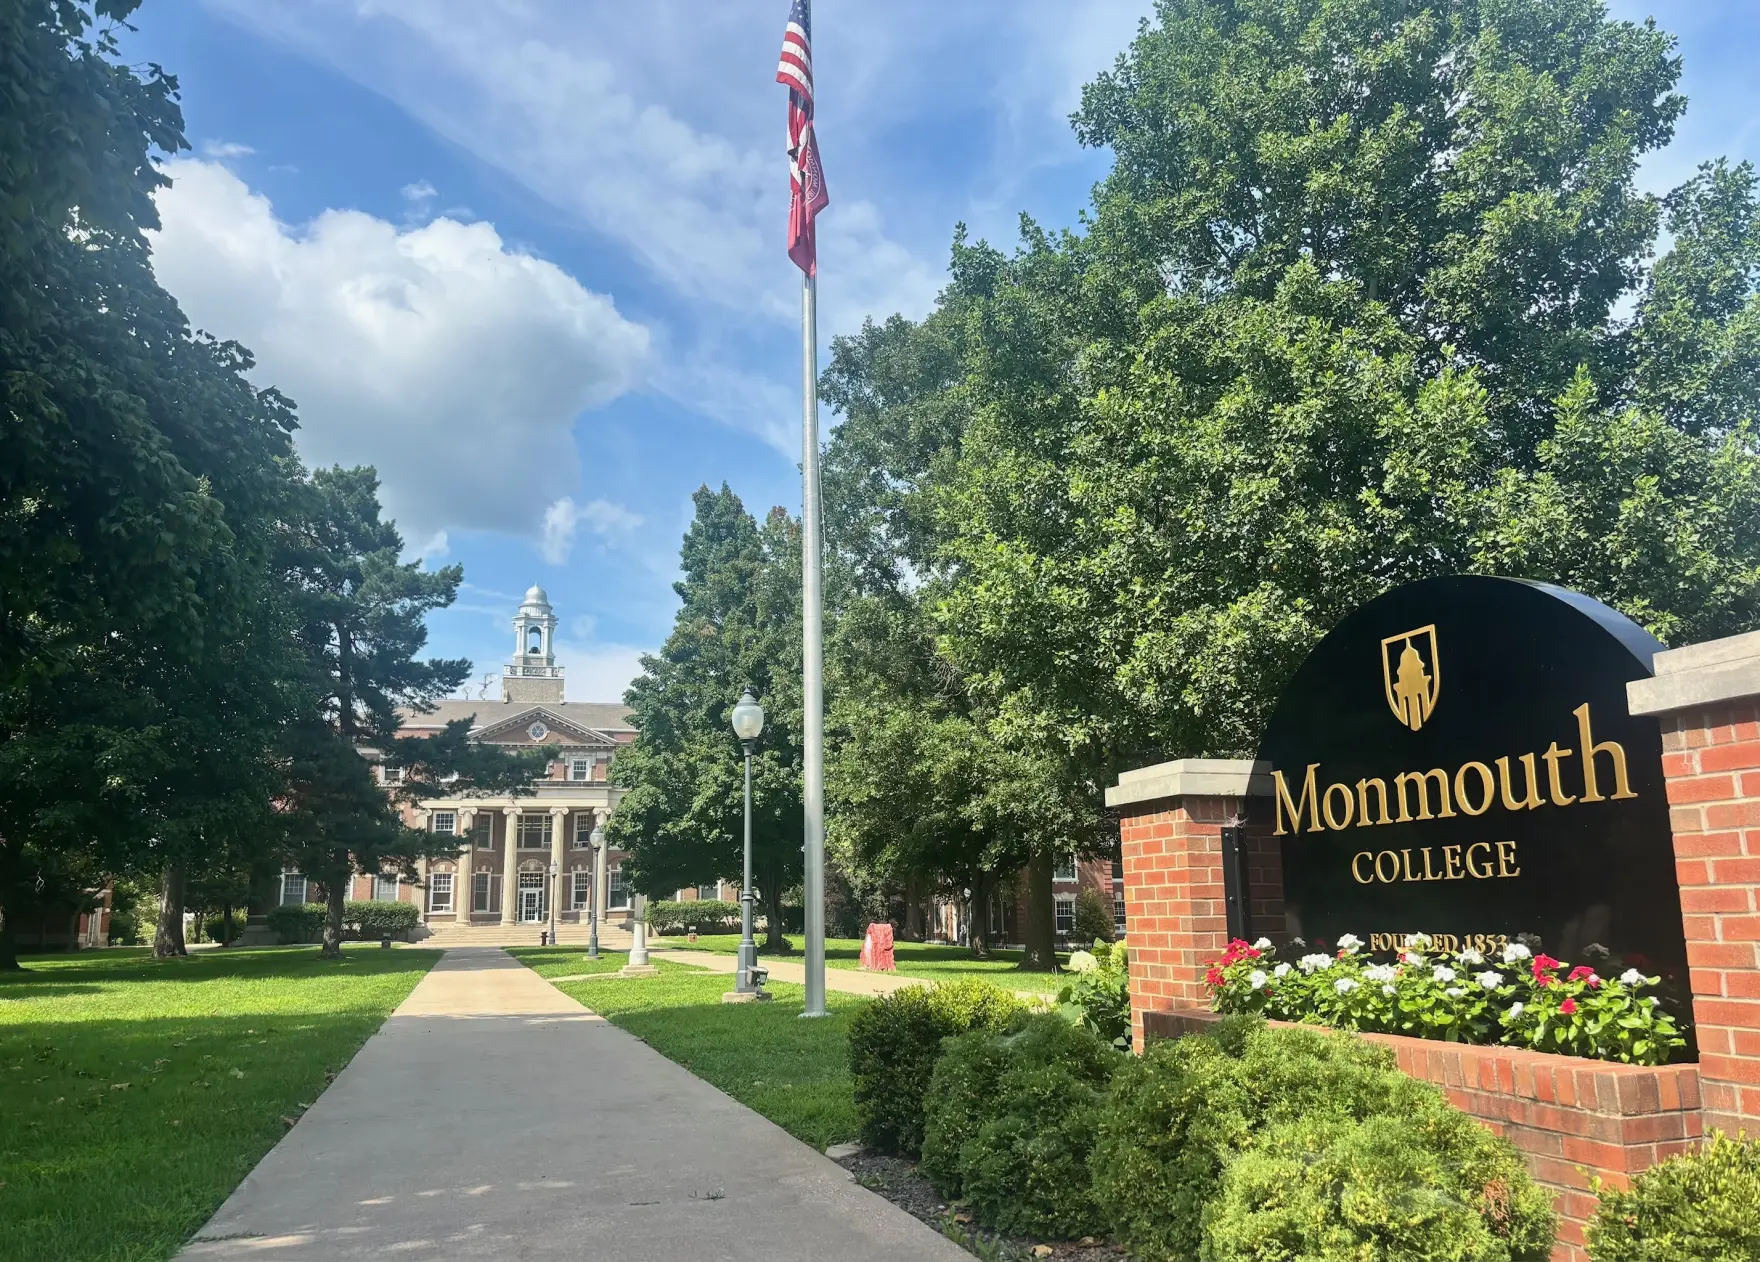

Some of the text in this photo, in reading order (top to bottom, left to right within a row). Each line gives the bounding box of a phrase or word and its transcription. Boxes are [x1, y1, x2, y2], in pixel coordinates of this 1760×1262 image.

[1272, 703, 1638, 836] Monmouth
[1352, 840, 1521, 884] COLLEGE
[1370, 932, 1507, 956] FOUED 1853
